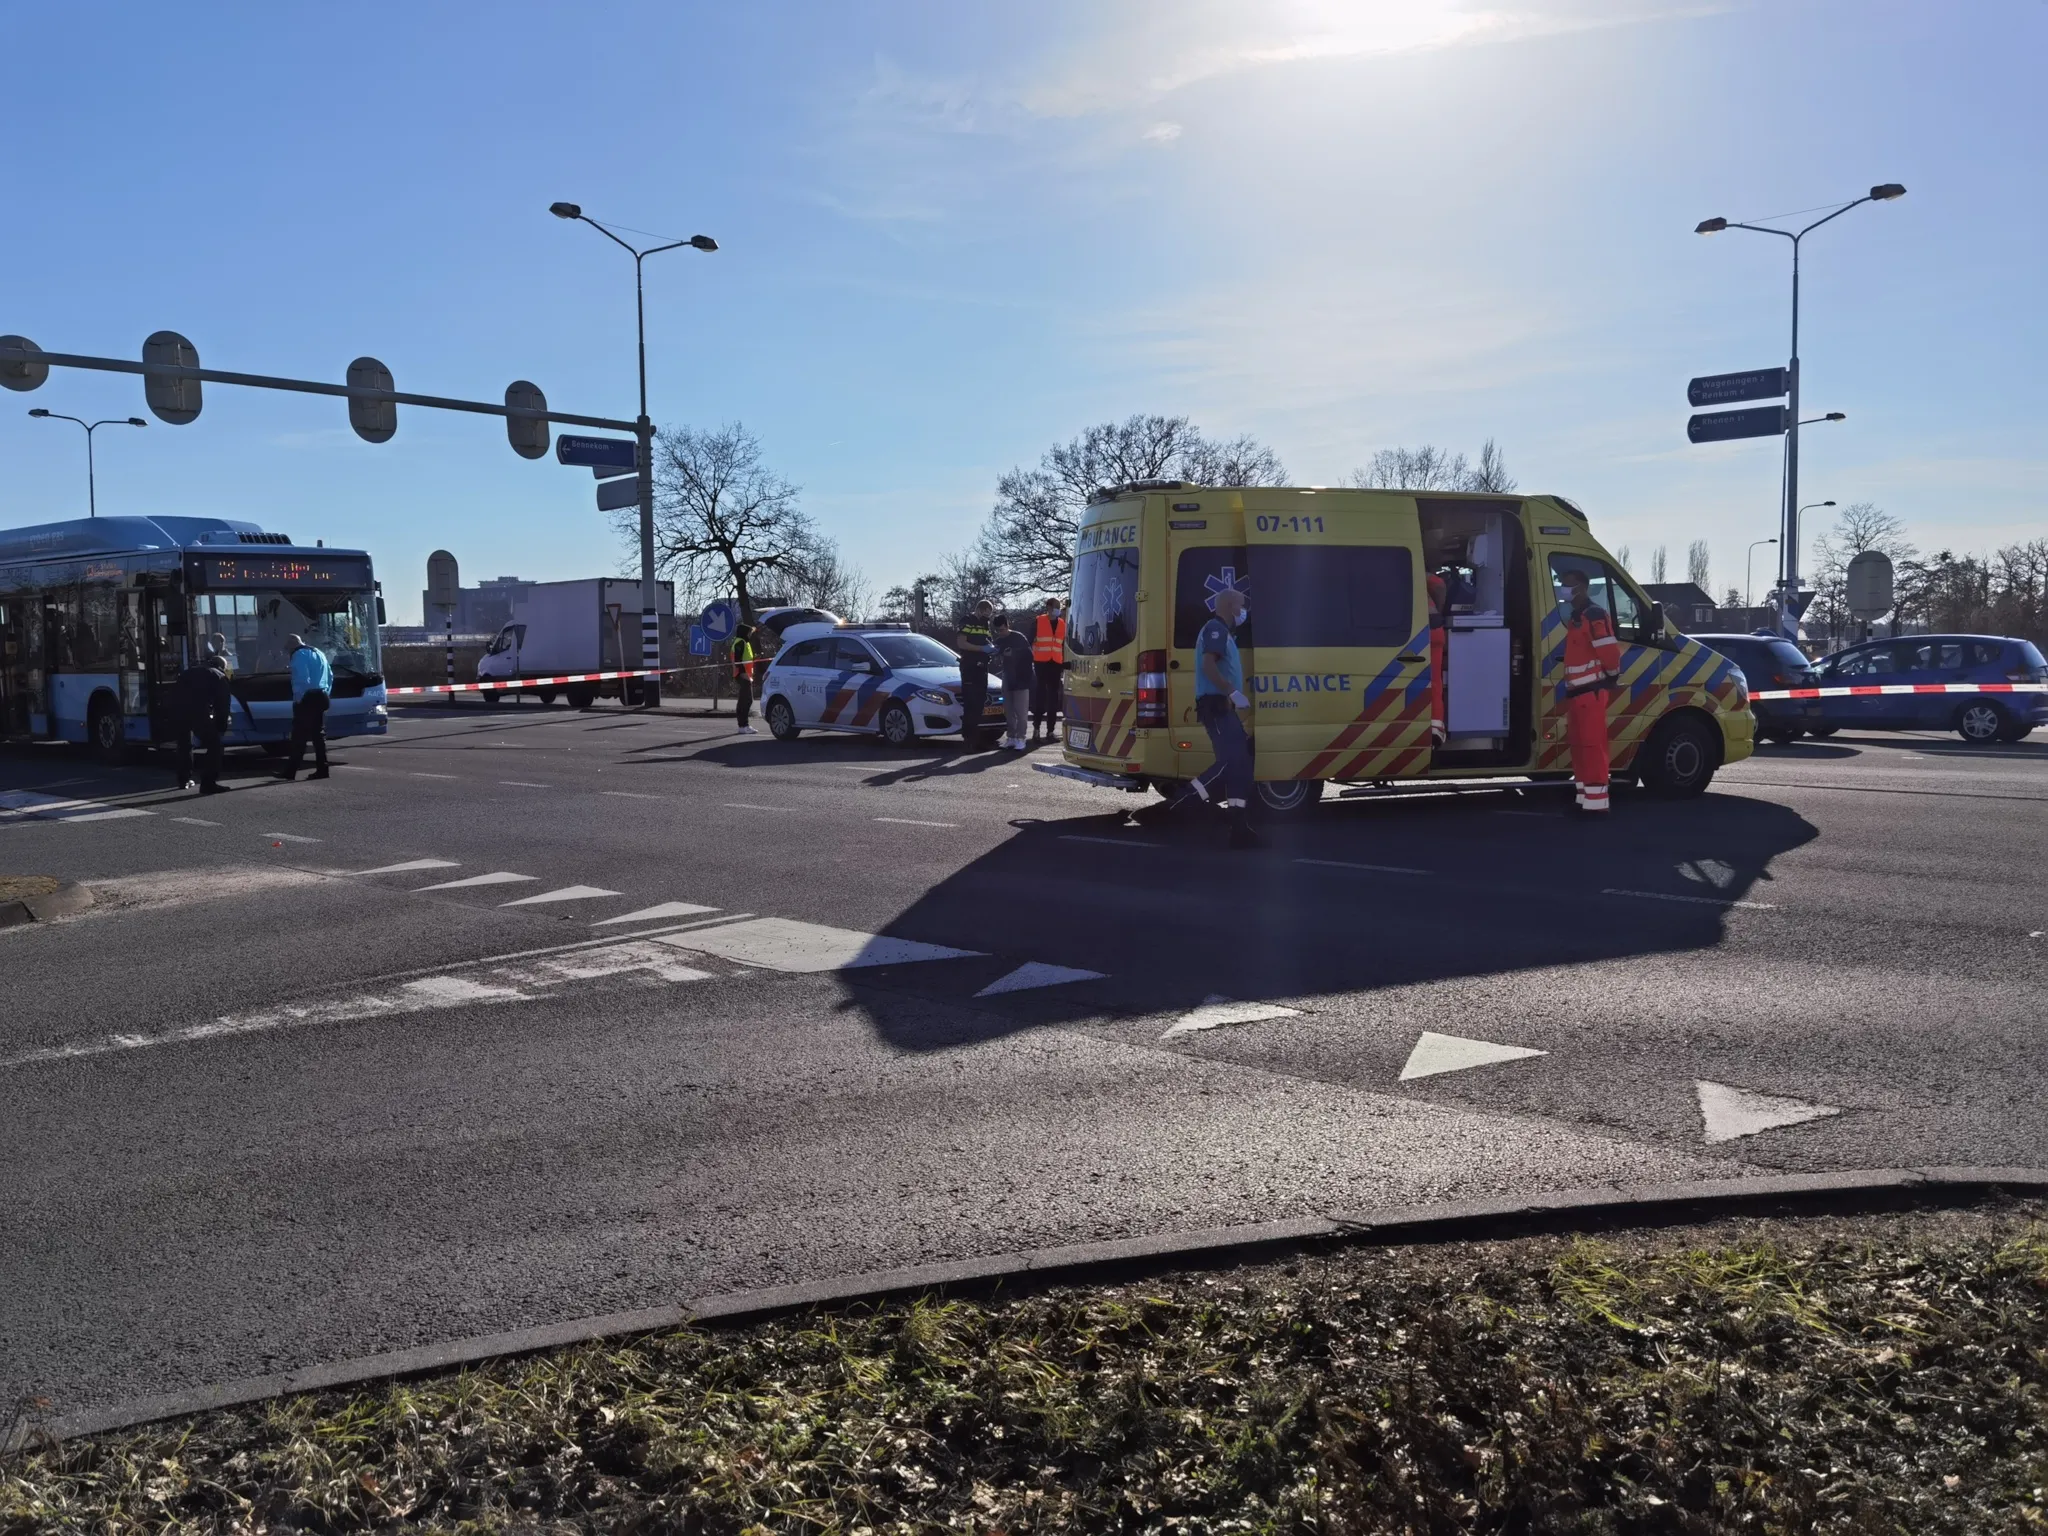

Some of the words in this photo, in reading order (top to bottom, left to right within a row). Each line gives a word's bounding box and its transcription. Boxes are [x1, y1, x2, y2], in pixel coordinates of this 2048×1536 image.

[1702, 376, 1757, 388] Wageningen
[1702, 390, 1737, 400] Renkum
[1702, 417, 1735, 425] Rhenen
[571, 440, 610, 451] Bennekom
[1256, 515, 1324, 532] 07-111
[797, 681, 823, 695] POLITIE
[1258, 699, 1299, 709] Midden
